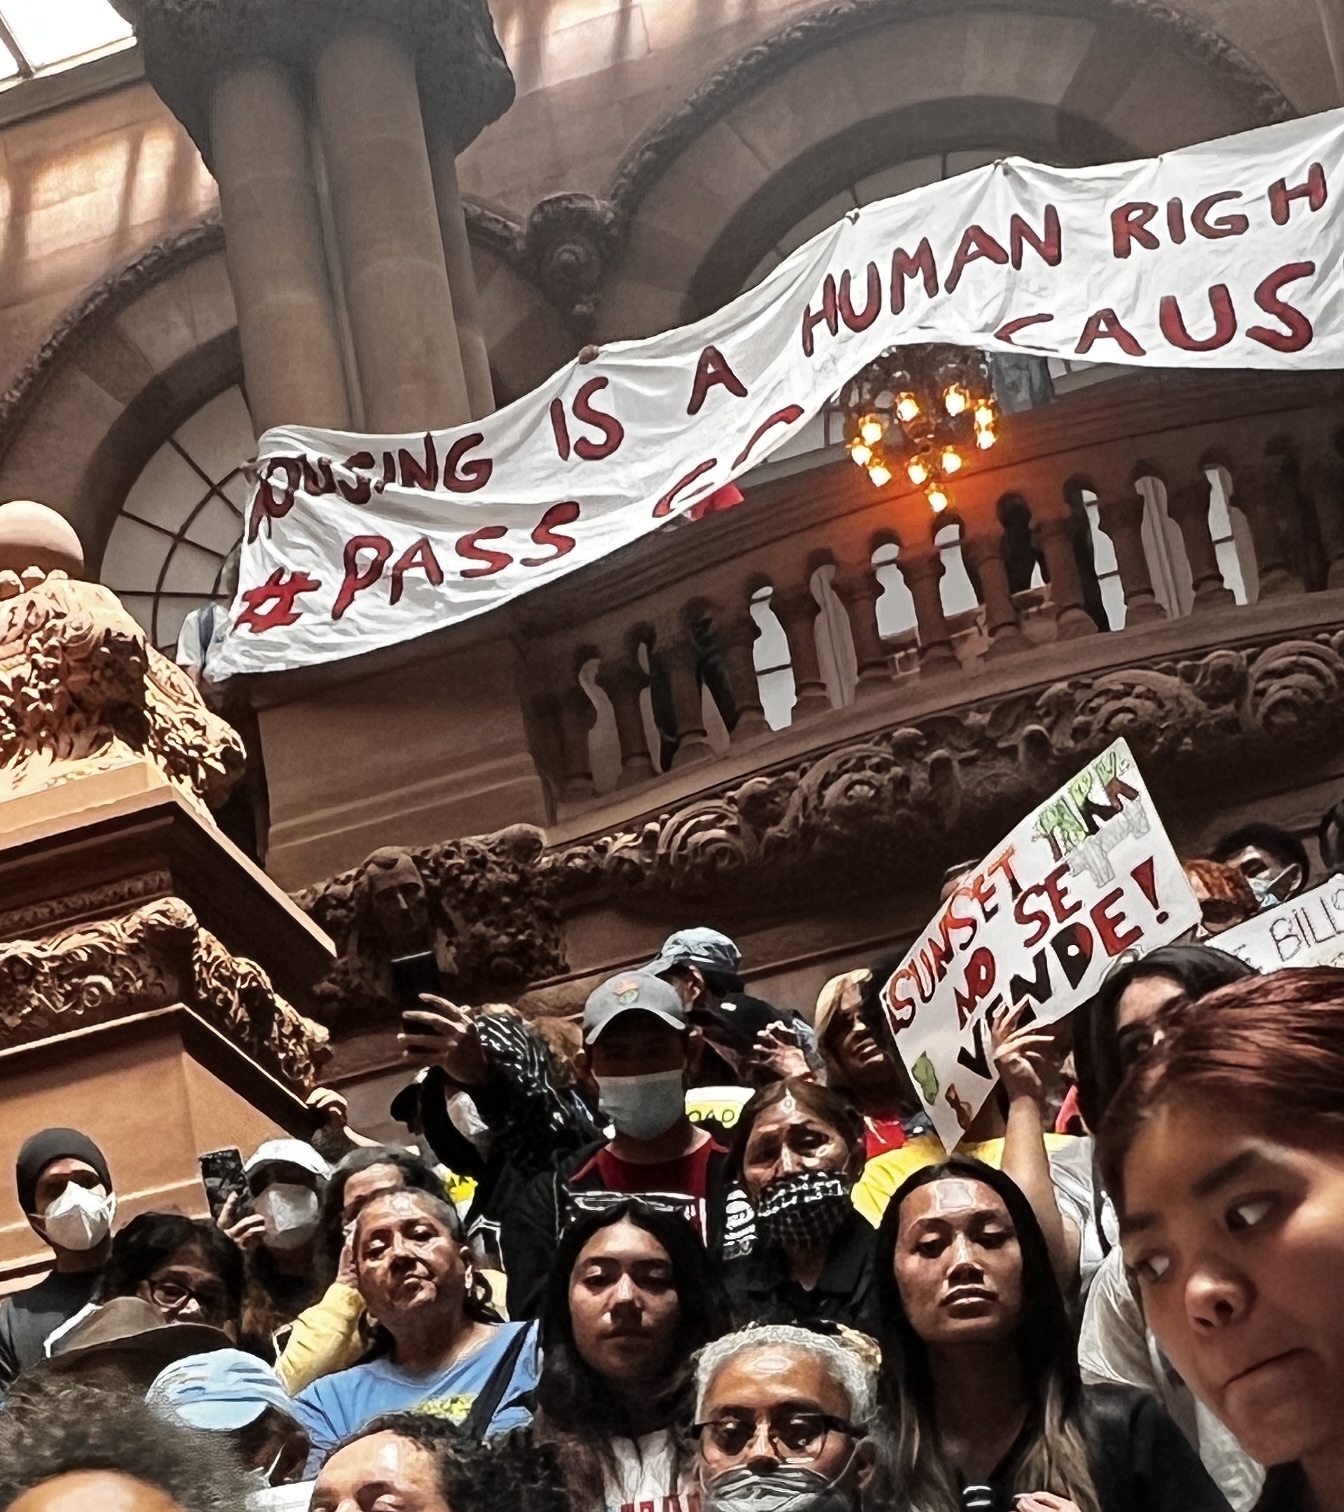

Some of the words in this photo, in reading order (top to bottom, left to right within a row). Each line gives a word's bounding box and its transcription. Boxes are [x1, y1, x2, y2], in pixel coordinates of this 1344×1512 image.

[550, 376, 624, 461] IS
[687, 344, 748, 415] A
[802, 204, 1062, 356] HUMAN
[886, 843, 1023, 1035] SUNSET
[954, 946, 996, 1032] NO
[1014, 864, 1083, 949] SE
